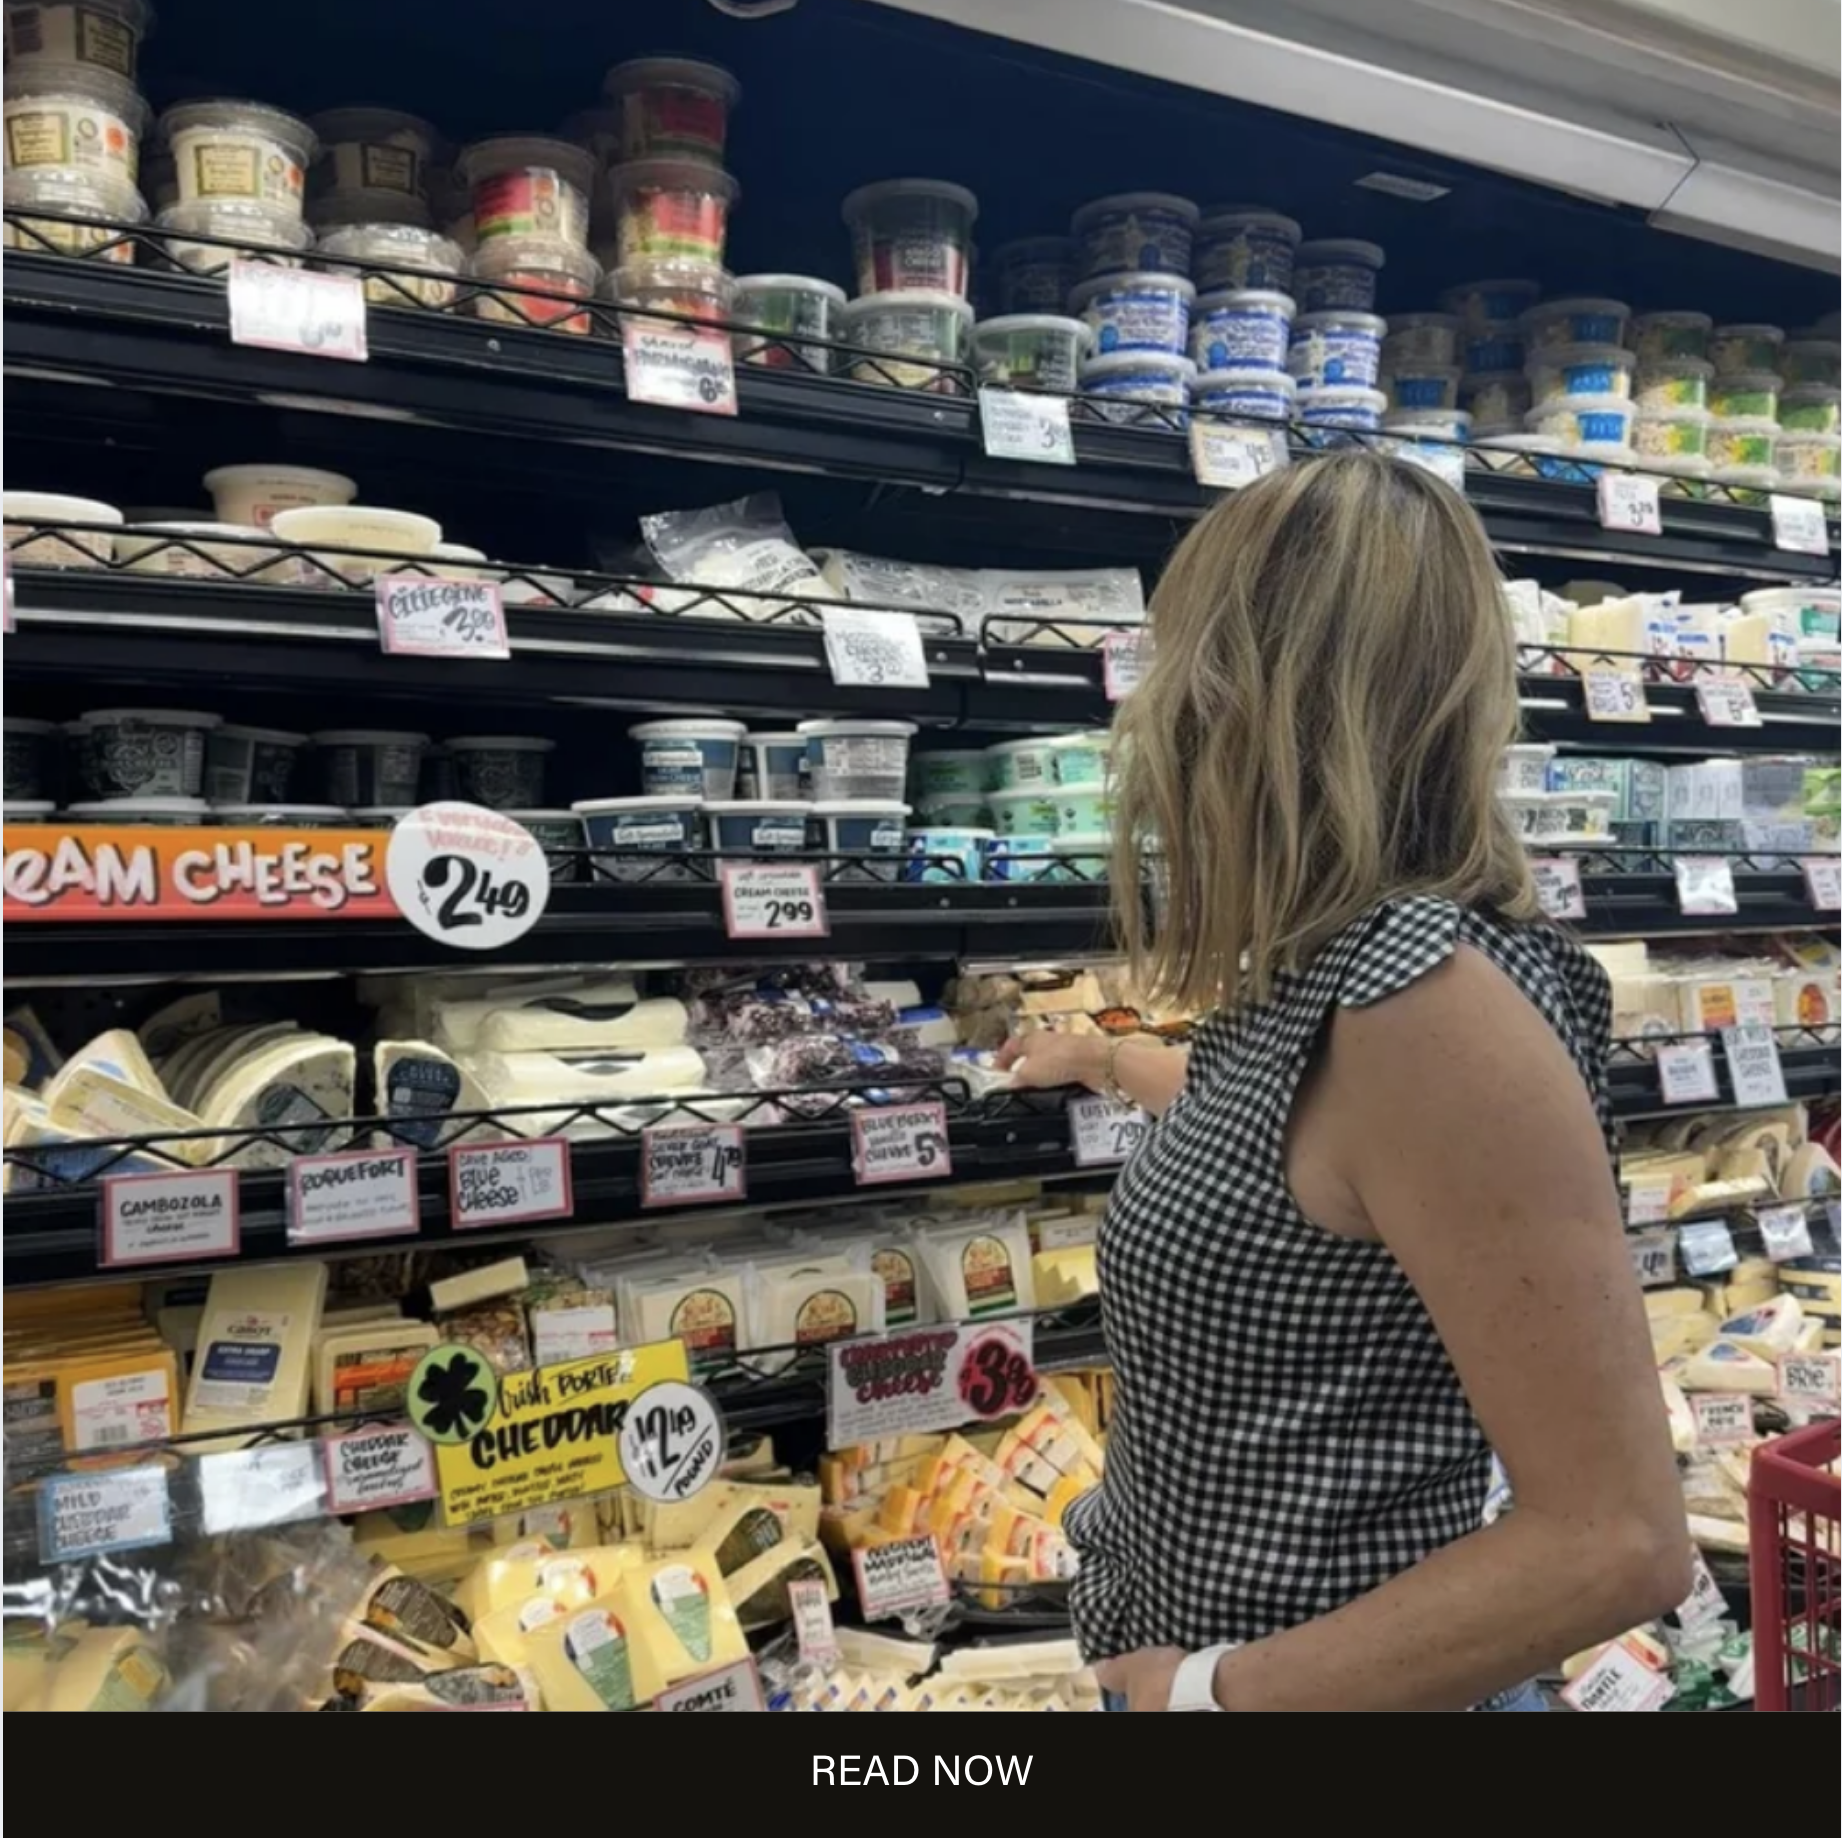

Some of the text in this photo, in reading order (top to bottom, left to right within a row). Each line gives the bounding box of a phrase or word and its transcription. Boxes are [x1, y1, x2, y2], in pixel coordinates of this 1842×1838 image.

[172, 840, 378, 909] CHEESE
[300, 1158, 404, 1198] ROQUEFORT
[119, 1193, 223, 1218] CAMBOZOLA
[470, 1399, 633, 1470] CHEDDAR
